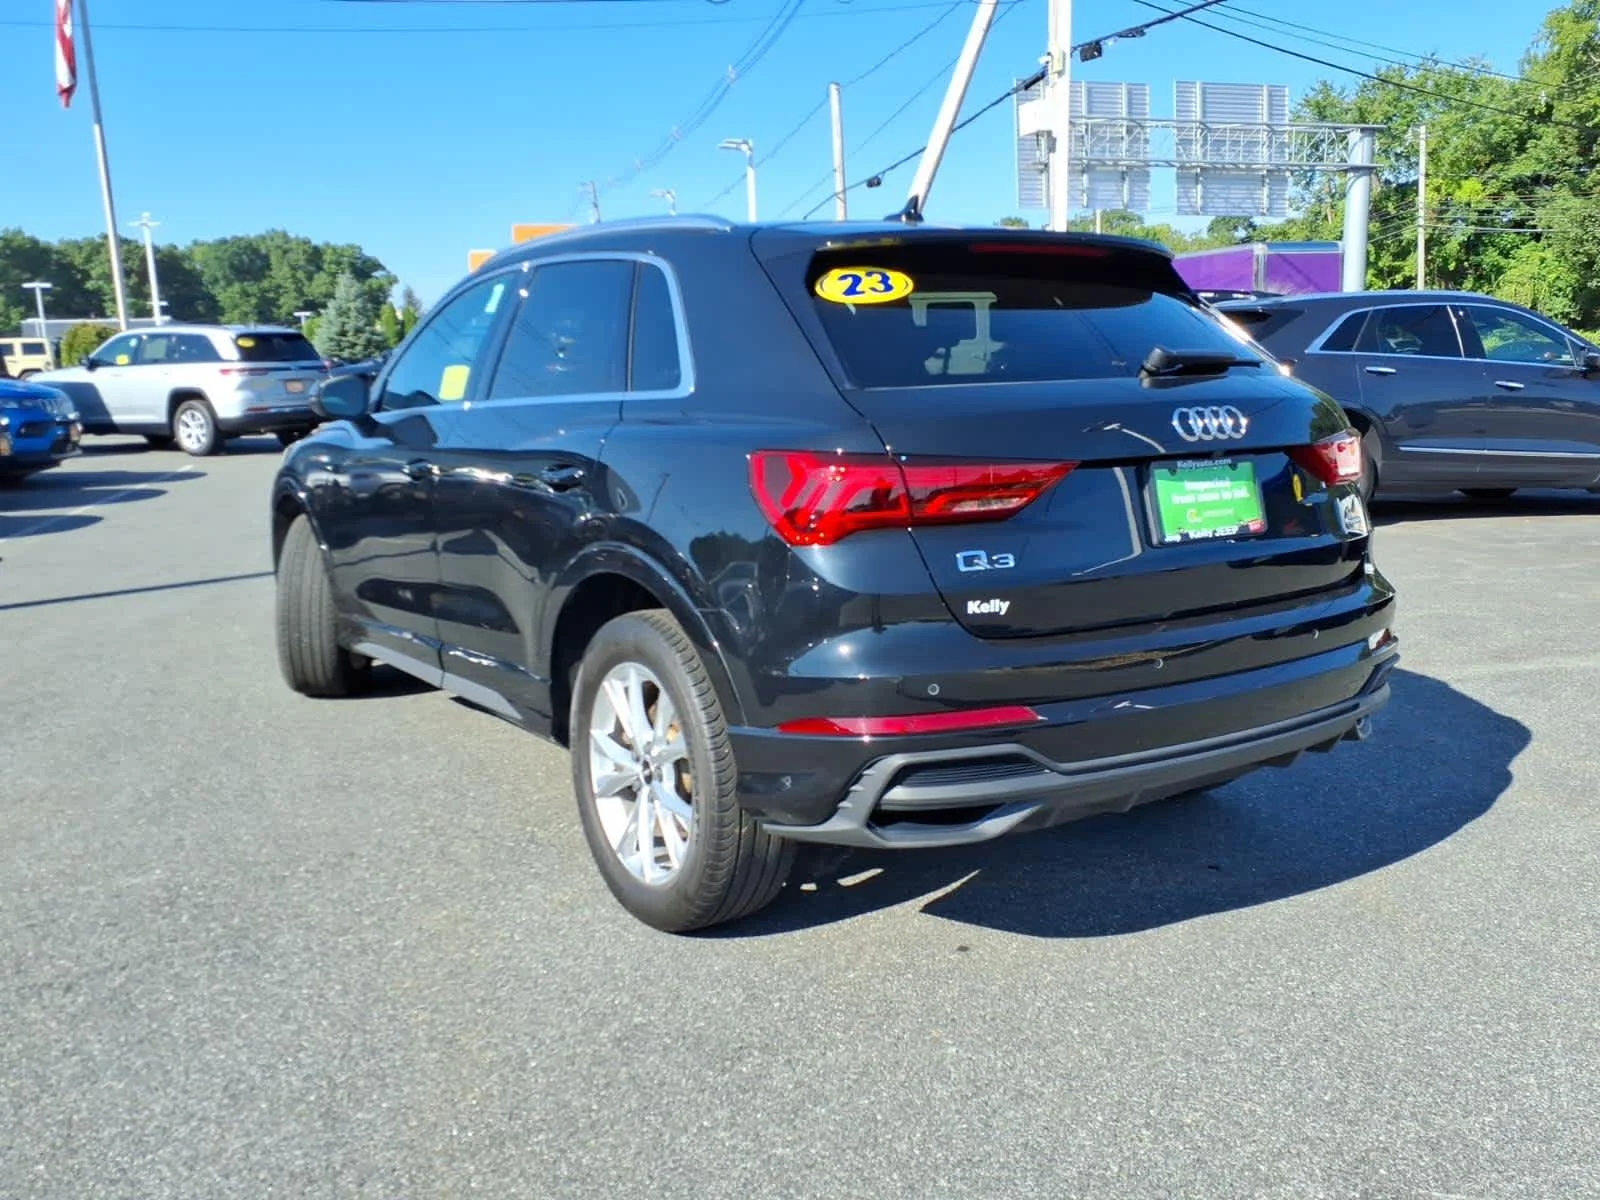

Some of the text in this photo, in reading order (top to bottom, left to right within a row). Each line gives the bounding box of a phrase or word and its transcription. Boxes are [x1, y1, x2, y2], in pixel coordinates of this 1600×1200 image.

[838, 271, 894, 296] 23
[956, 550, 1015, 572] Q3
[967, 599, 1010, 615] Kelly
